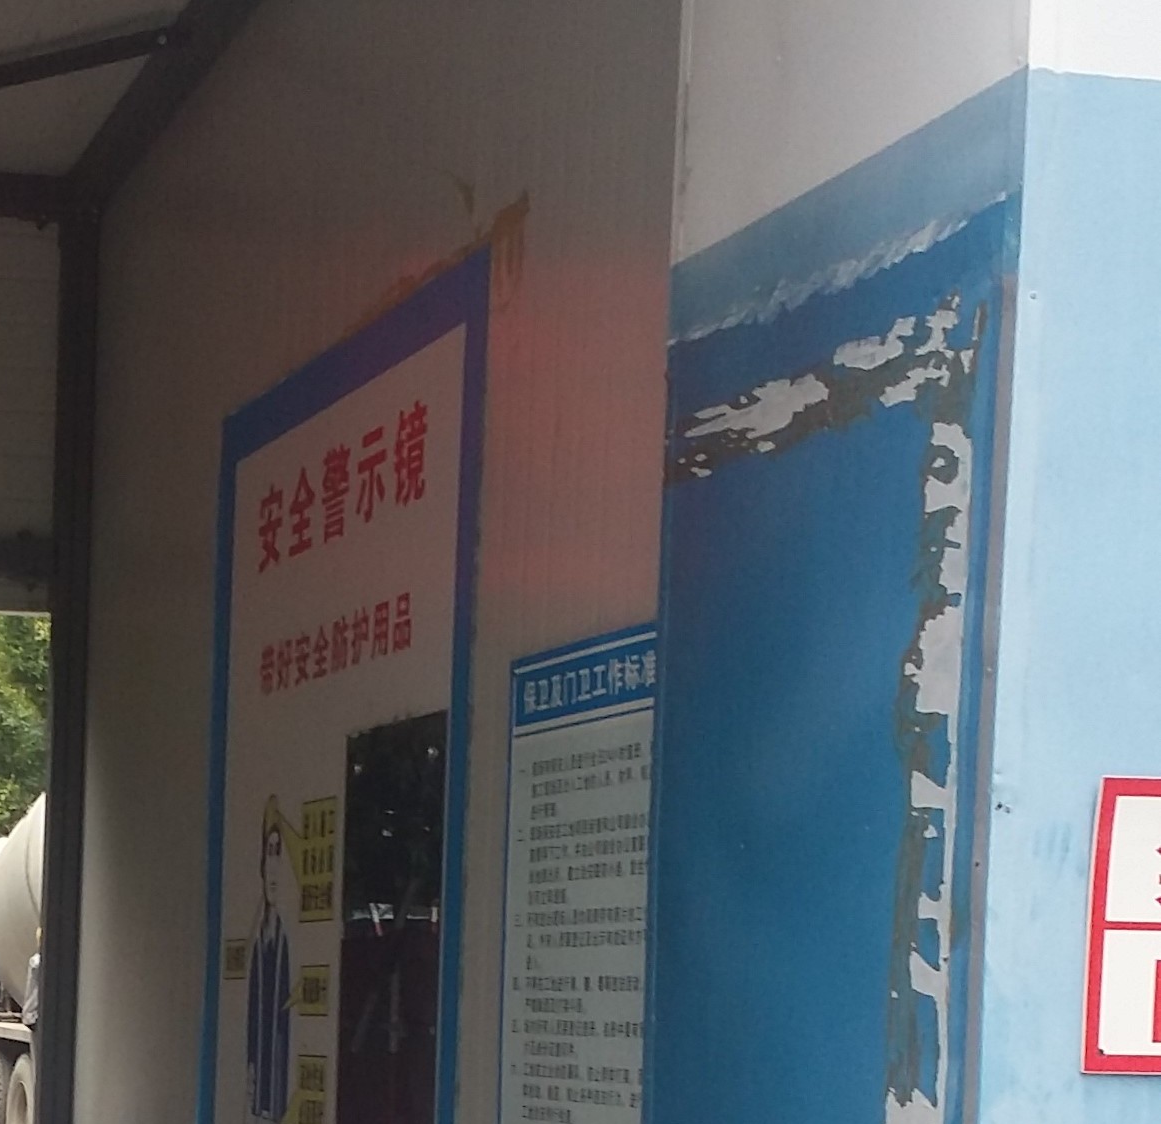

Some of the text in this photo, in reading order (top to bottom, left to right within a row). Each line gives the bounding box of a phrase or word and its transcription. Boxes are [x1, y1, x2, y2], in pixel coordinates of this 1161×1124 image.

[257, 400, 429, 574] 安全警示镜
